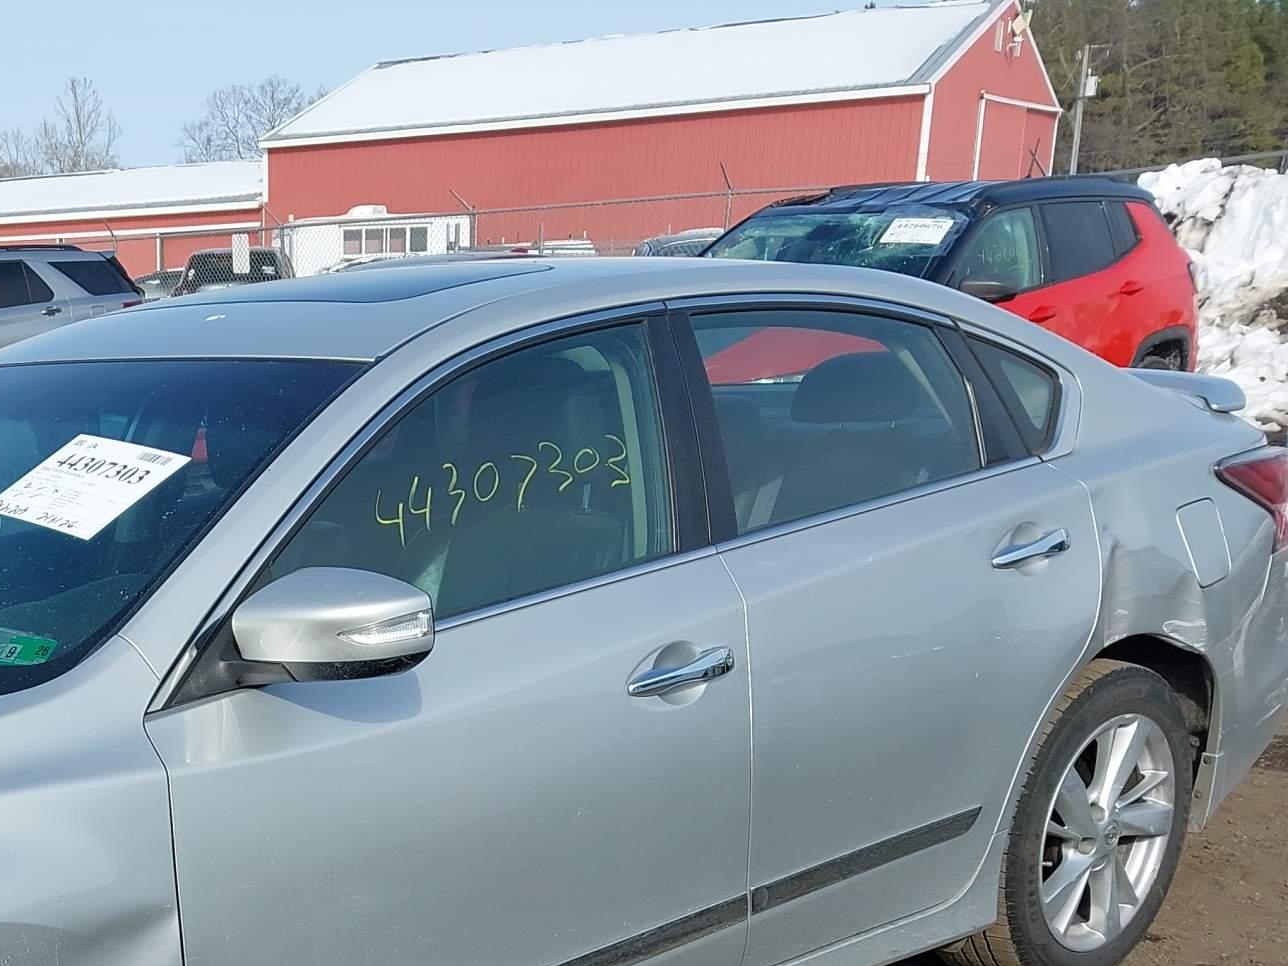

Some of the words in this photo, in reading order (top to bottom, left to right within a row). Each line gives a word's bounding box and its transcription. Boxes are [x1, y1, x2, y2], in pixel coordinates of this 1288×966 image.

[56, 453, 152, 485] 44307303
[374, 434, 631, 547] 44307303
[5, 645, 18, 658] 9
[34, 644, 51, 657] 26
